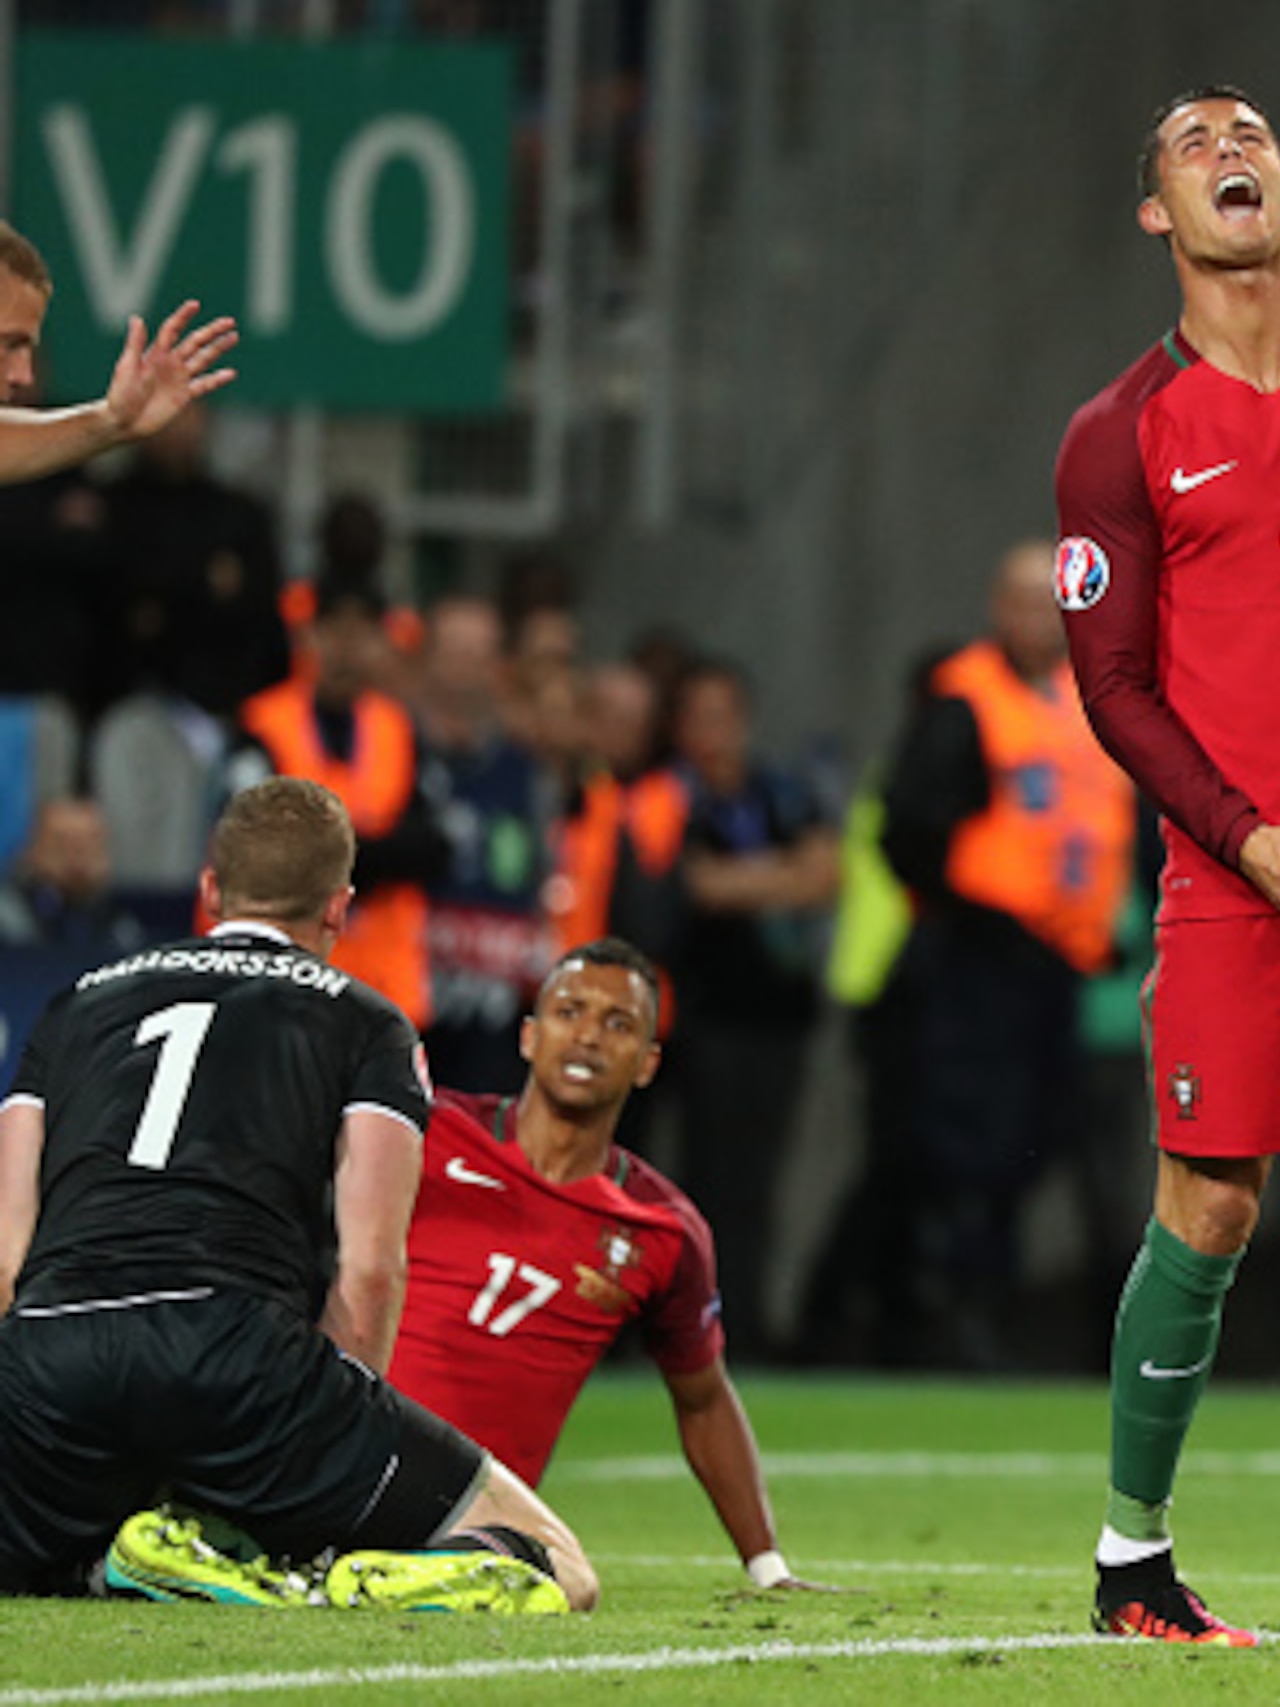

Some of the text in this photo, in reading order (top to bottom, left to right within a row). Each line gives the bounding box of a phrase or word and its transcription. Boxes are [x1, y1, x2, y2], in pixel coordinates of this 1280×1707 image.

[43, 105, 476, 341] V10
[127, 1002, 217, 1170] 1
[467, 1253, 562, 1336] 17
